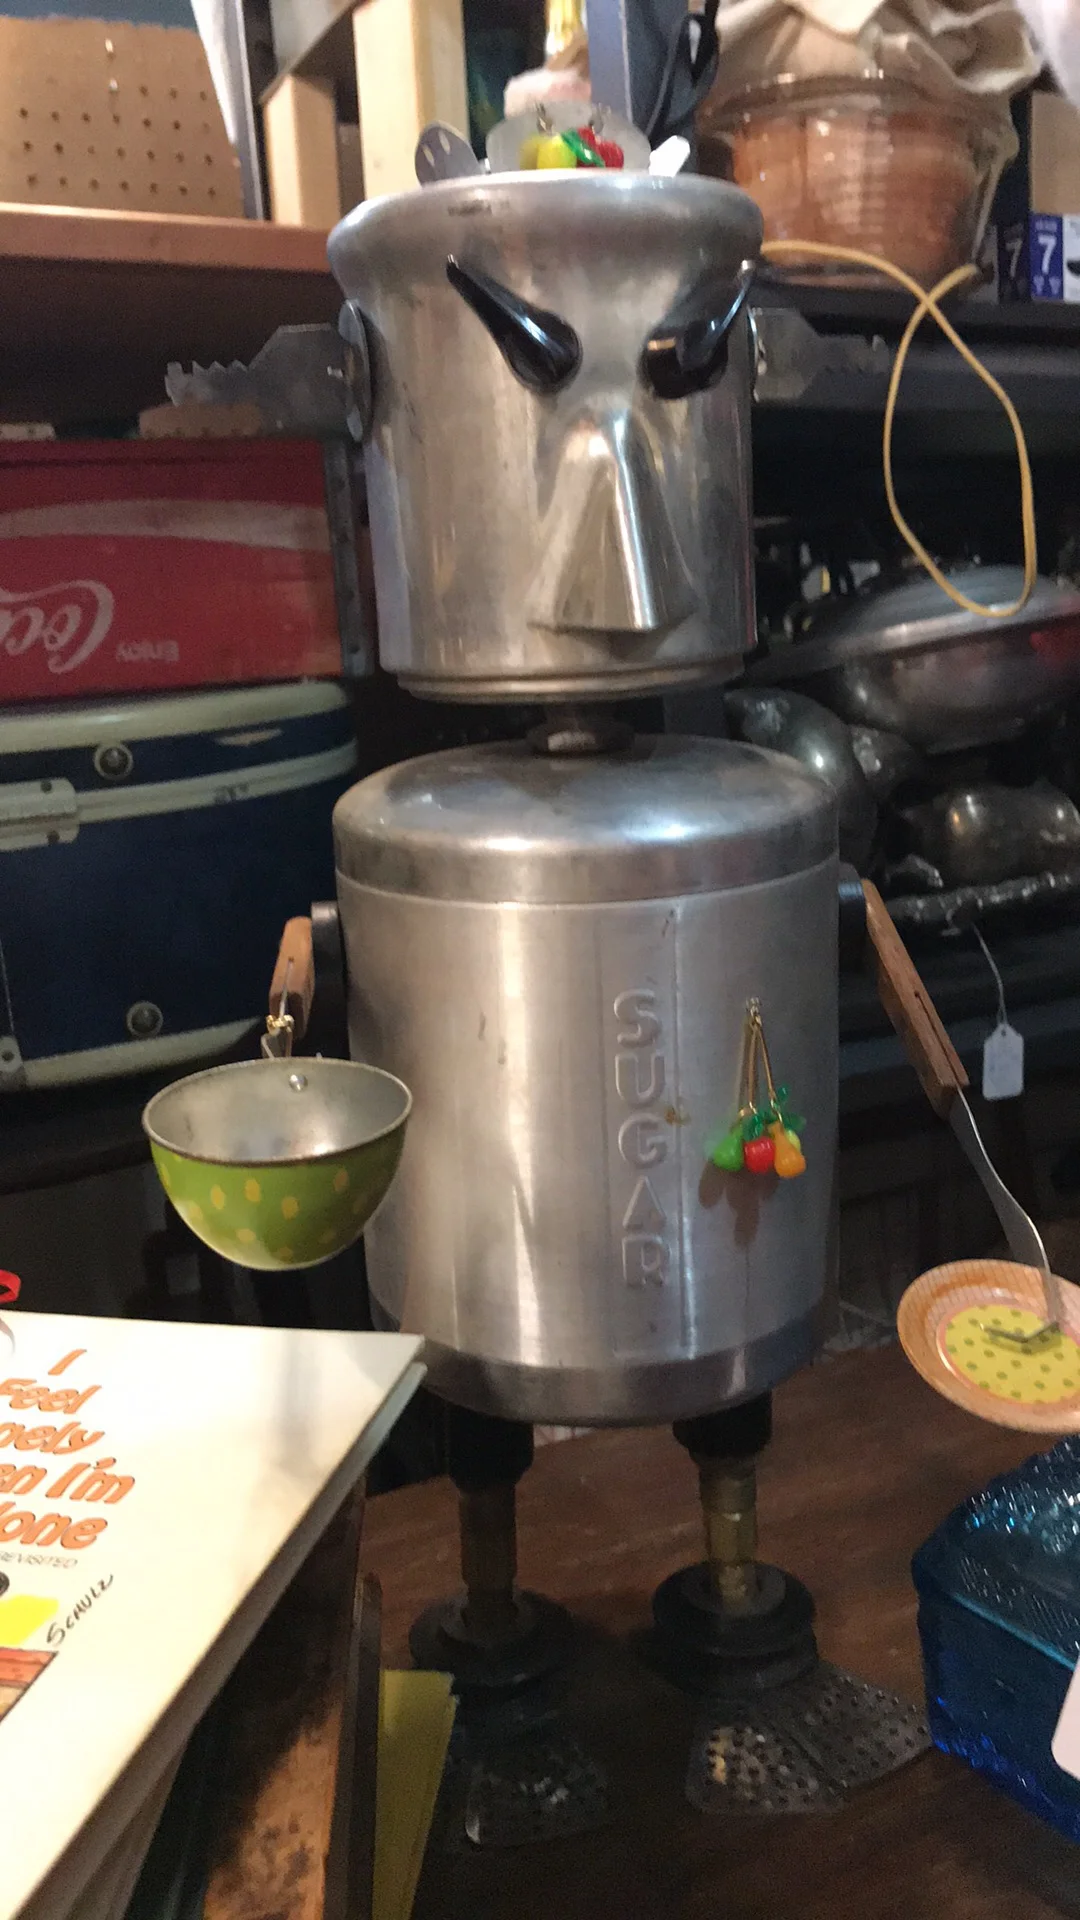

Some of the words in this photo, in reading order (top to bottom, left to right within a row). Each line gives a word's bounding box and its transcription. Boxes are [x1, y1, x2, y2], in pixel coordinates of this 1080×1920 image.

[1038, 235, 1057, 275] 7
[612, 988, 672, 1289] SUGAR
[48, 1349, 87, 1375] I
[0, 1378, 102, 1414] Feel
[46, 1457, 135, 1504] I'm
